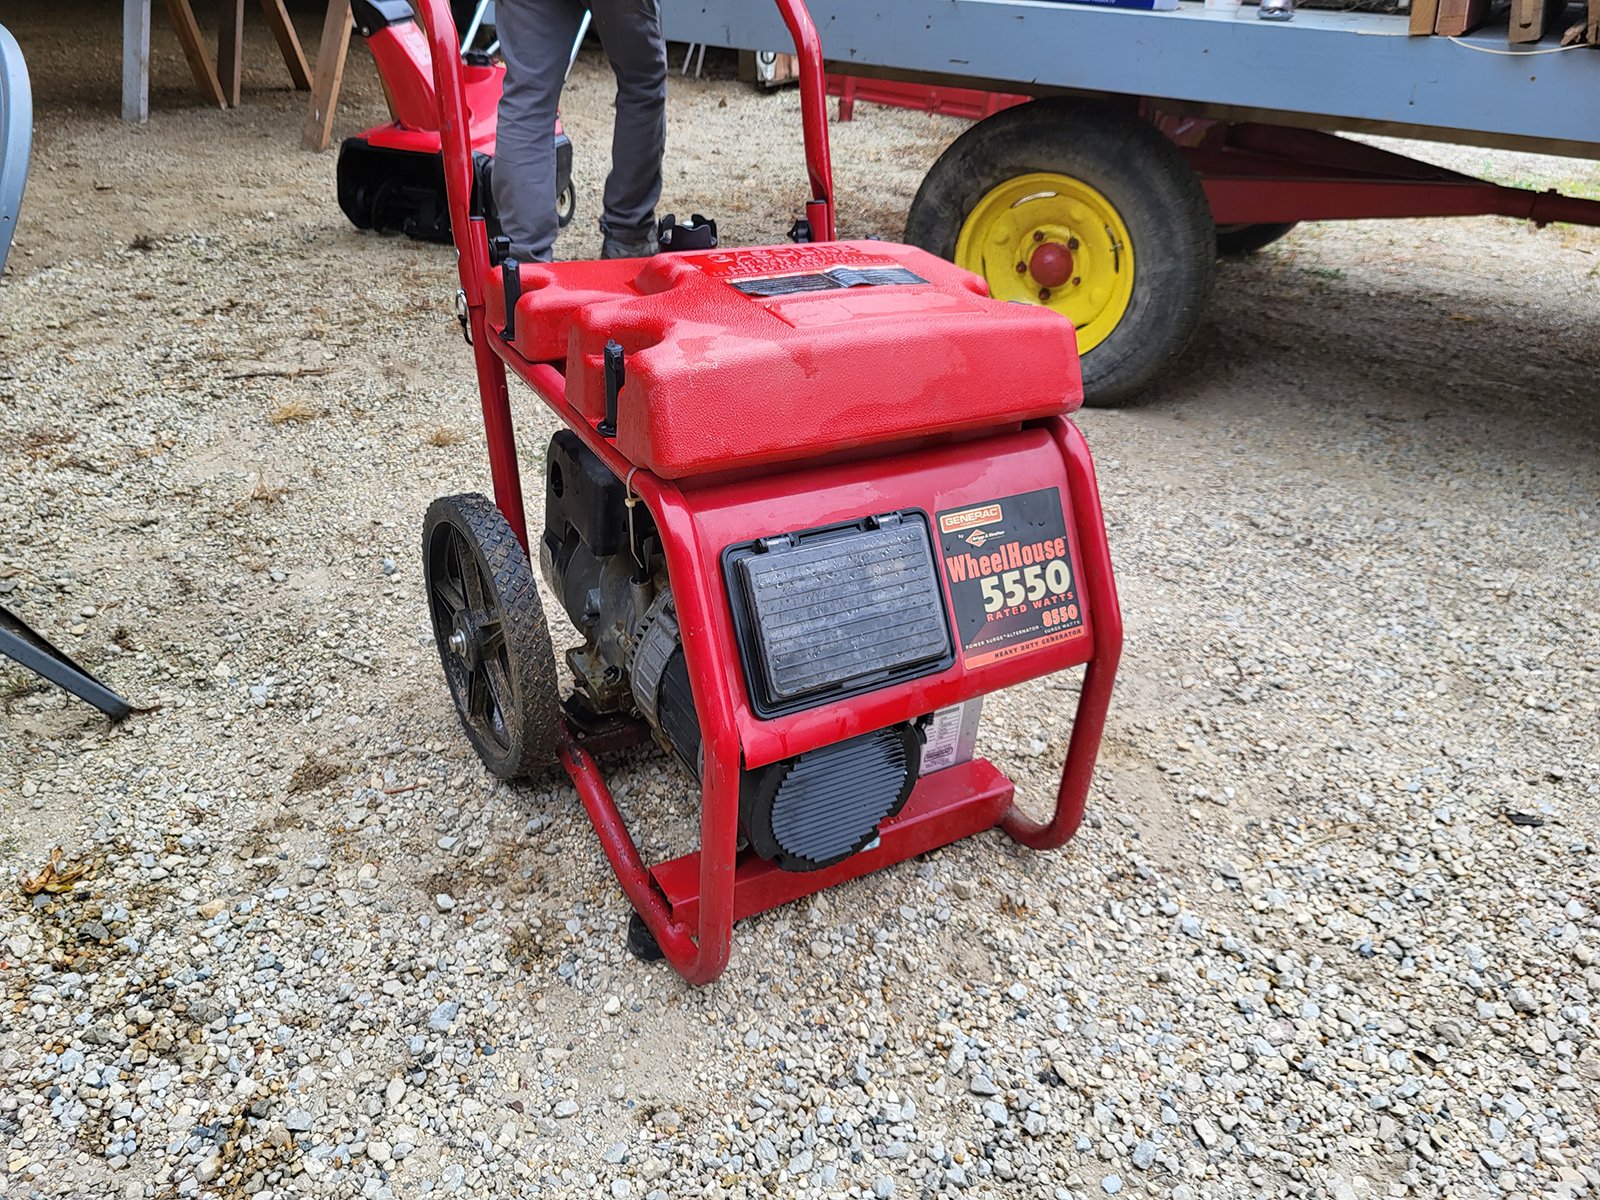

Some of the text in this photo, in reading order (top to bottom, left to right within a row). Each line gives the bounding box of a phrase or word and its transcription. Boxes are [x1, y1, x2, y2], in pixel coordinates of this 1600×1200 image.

[945, 507, 999, 527] GENERAC
[980, 560, 1071, 613] 5550
[986, 591, 1074, 622] RATED WATTS
[1042, 604, 1078, 627] 8550
[1044, 620, 1081, 634] SURGE WATTS
[965, 640, 985, 650] POWER
[994, 629, 1082, 659] HEAVY DUTY GENERATOR
